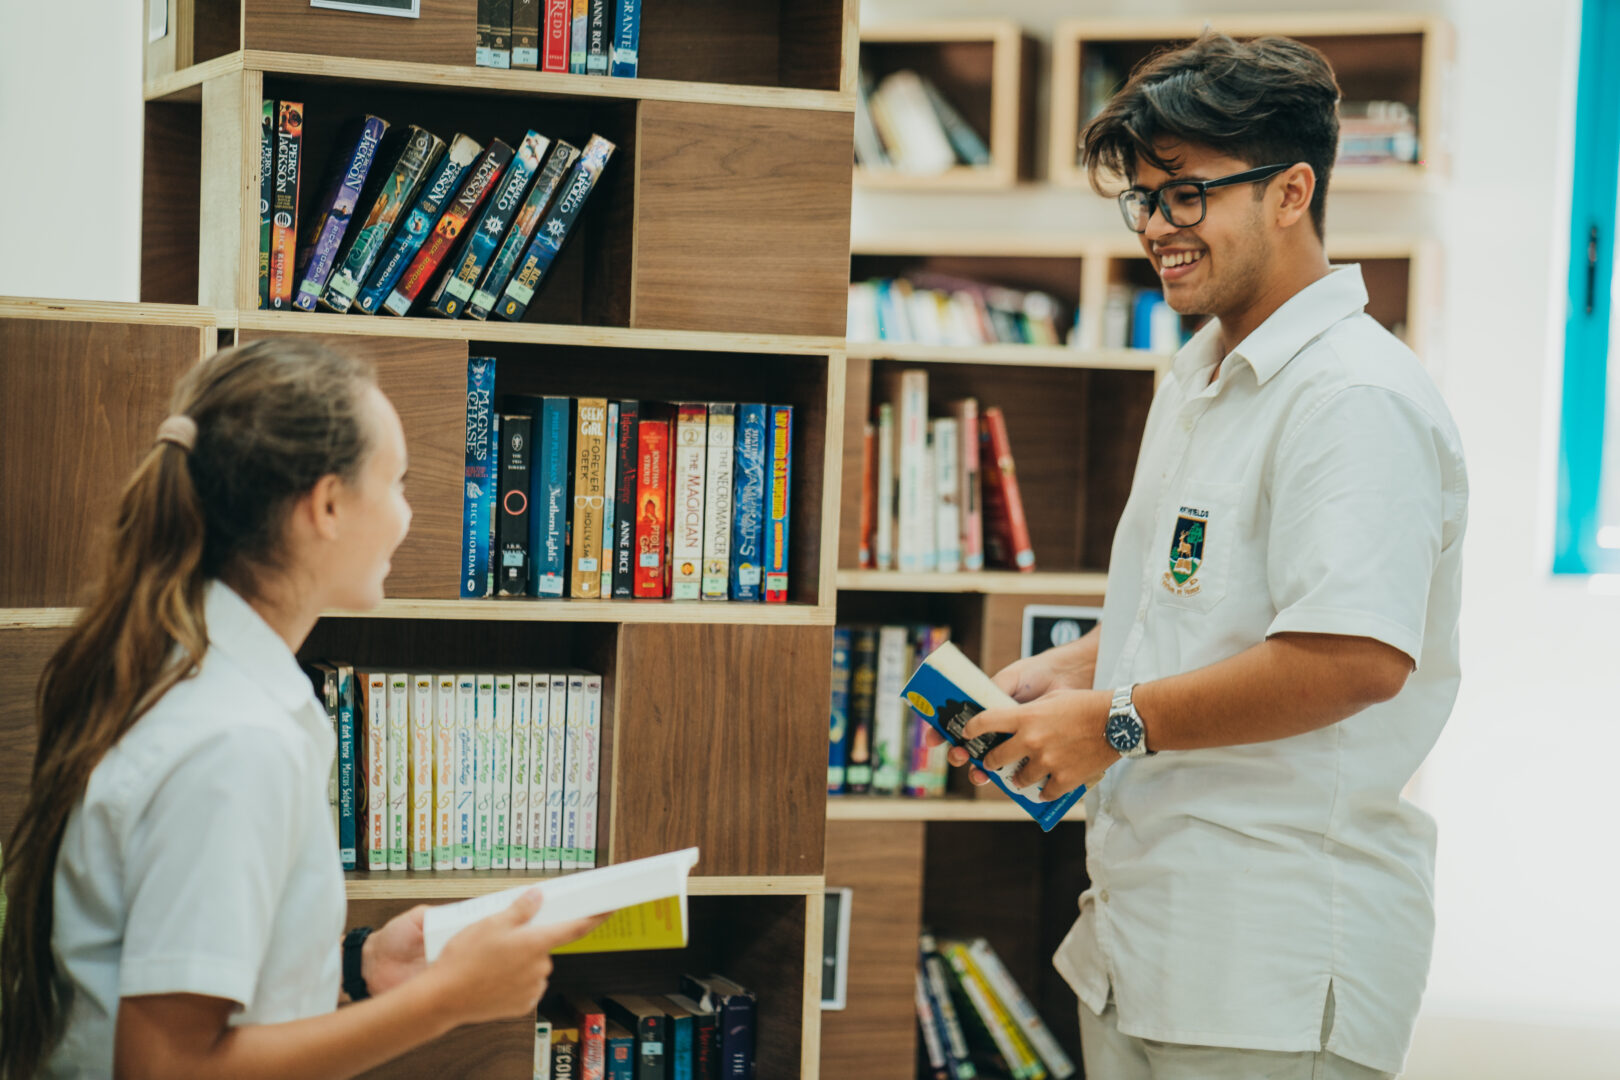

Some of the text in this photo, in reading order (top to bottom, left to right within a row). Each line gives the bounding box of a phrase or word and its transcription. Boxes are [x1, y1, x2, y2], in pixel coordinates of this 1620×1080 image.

[593, 0, 603, 27] ANNE
[592, 30, 603, 54] RICE
[264, 147, 272, 177] PERCY
[277, 132, 293, 193] JACKSON
[287, 143, 298, 184] PERCY
[345, 129, 378, 191] JACKSON
[459, 152, 501, 210] JACKSON
[498, 163, 525, 211] APOLLO
[510, 175, 529, 206] TRIALS
[560, 167, 589, 213] APOLLO
[572, 179, 592, 209] TRIALS
[329, 225, 339, 244] RICK
[259, 252, 268, 277] RICK
[275, 229, 286, 294] RICK RIORDAN
[376, 234, 413, 288] RICK RIORDAN
[405, 238, 443, 291] RICK RIORDAN
[466, 391, 479, 456] CHASE
[476, 388, 489, 461] MAGNUS
[581, 407, 604, 421] GEEK
[581, 449, 590, 480] GEEK
[590, 438, 600, 492] FOREVER
[643, 455, 651, 485] STROUD
[652, 450, 660, 489] JONATHAN
[686, 452, 700, 548] THE MAGICIAN
[714, 451, 730, 556] THE NECROMANCER
[740, 463, 760, 557] VAMPIRATES
[584, 512, 592, 541] HOLLY
[468, 530, 477, 576] RIORDAN
[546, 531, 559, 562] Lights
[619, 520, 630, 574] ANNE RICE
[341, 712, 352, 817] the dark horse Marcus Sedgwick
[370, 792, 385, 810] 3
[391, 793, 405, 810] 4
[457, 791, 472, 809] 7
[478, 793, 492, 810] 8
[495, 793, 510, 810] 8
[513, 791, 526, 809] 9
[531, 791, 545, 809] 9
[547, 790, 562, 807] 10
[564, 789, 580, 807] 10
[582, 791, 598, 808] 11
